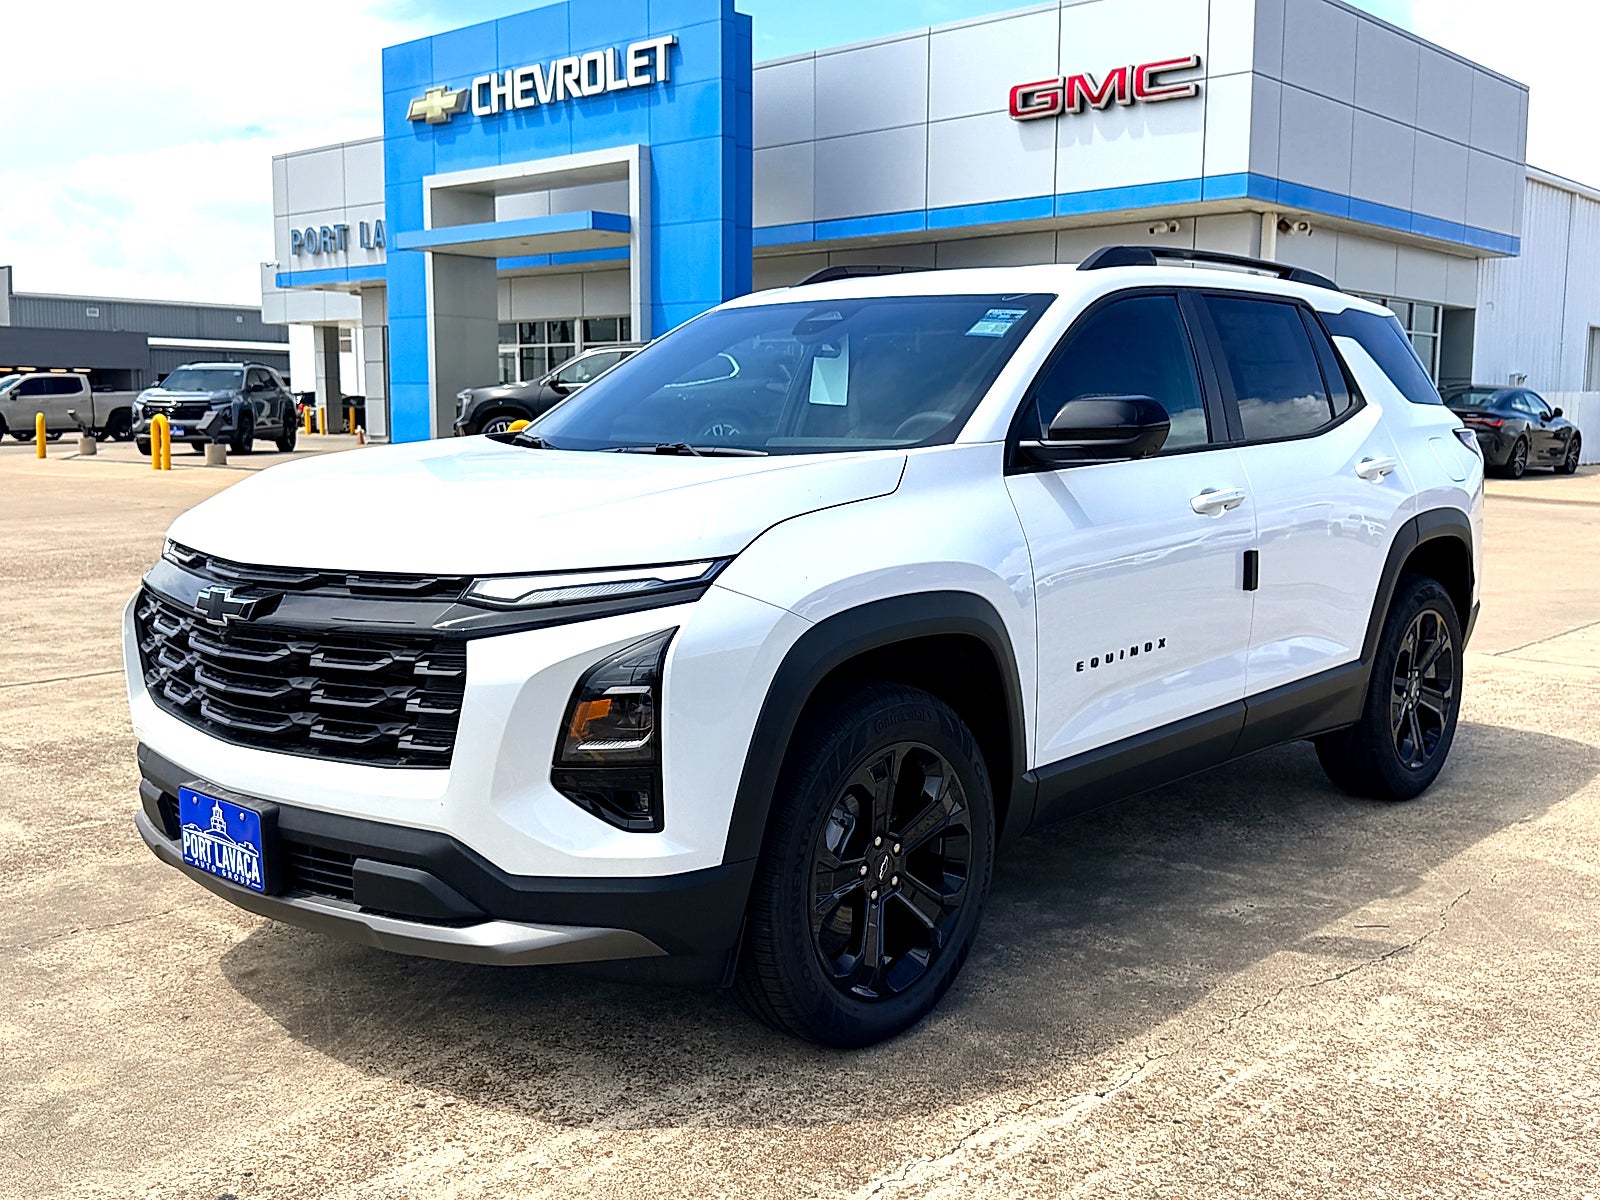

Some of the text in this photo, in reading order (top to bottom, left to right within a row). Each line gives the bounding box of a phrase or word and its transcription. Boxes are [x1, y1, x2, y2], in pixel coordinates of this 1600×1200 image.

[471, 34, 677, 116] CHEVROLET
[1008, 54, 1200, 121] GMC
[290, 223, 348, 256] PORT
[1076, 637, 1166, 672] EQUINOX
[182, 831, 261, 883] PORT LAVACA
[194, 859, 250, 885] AUTO GROUP
